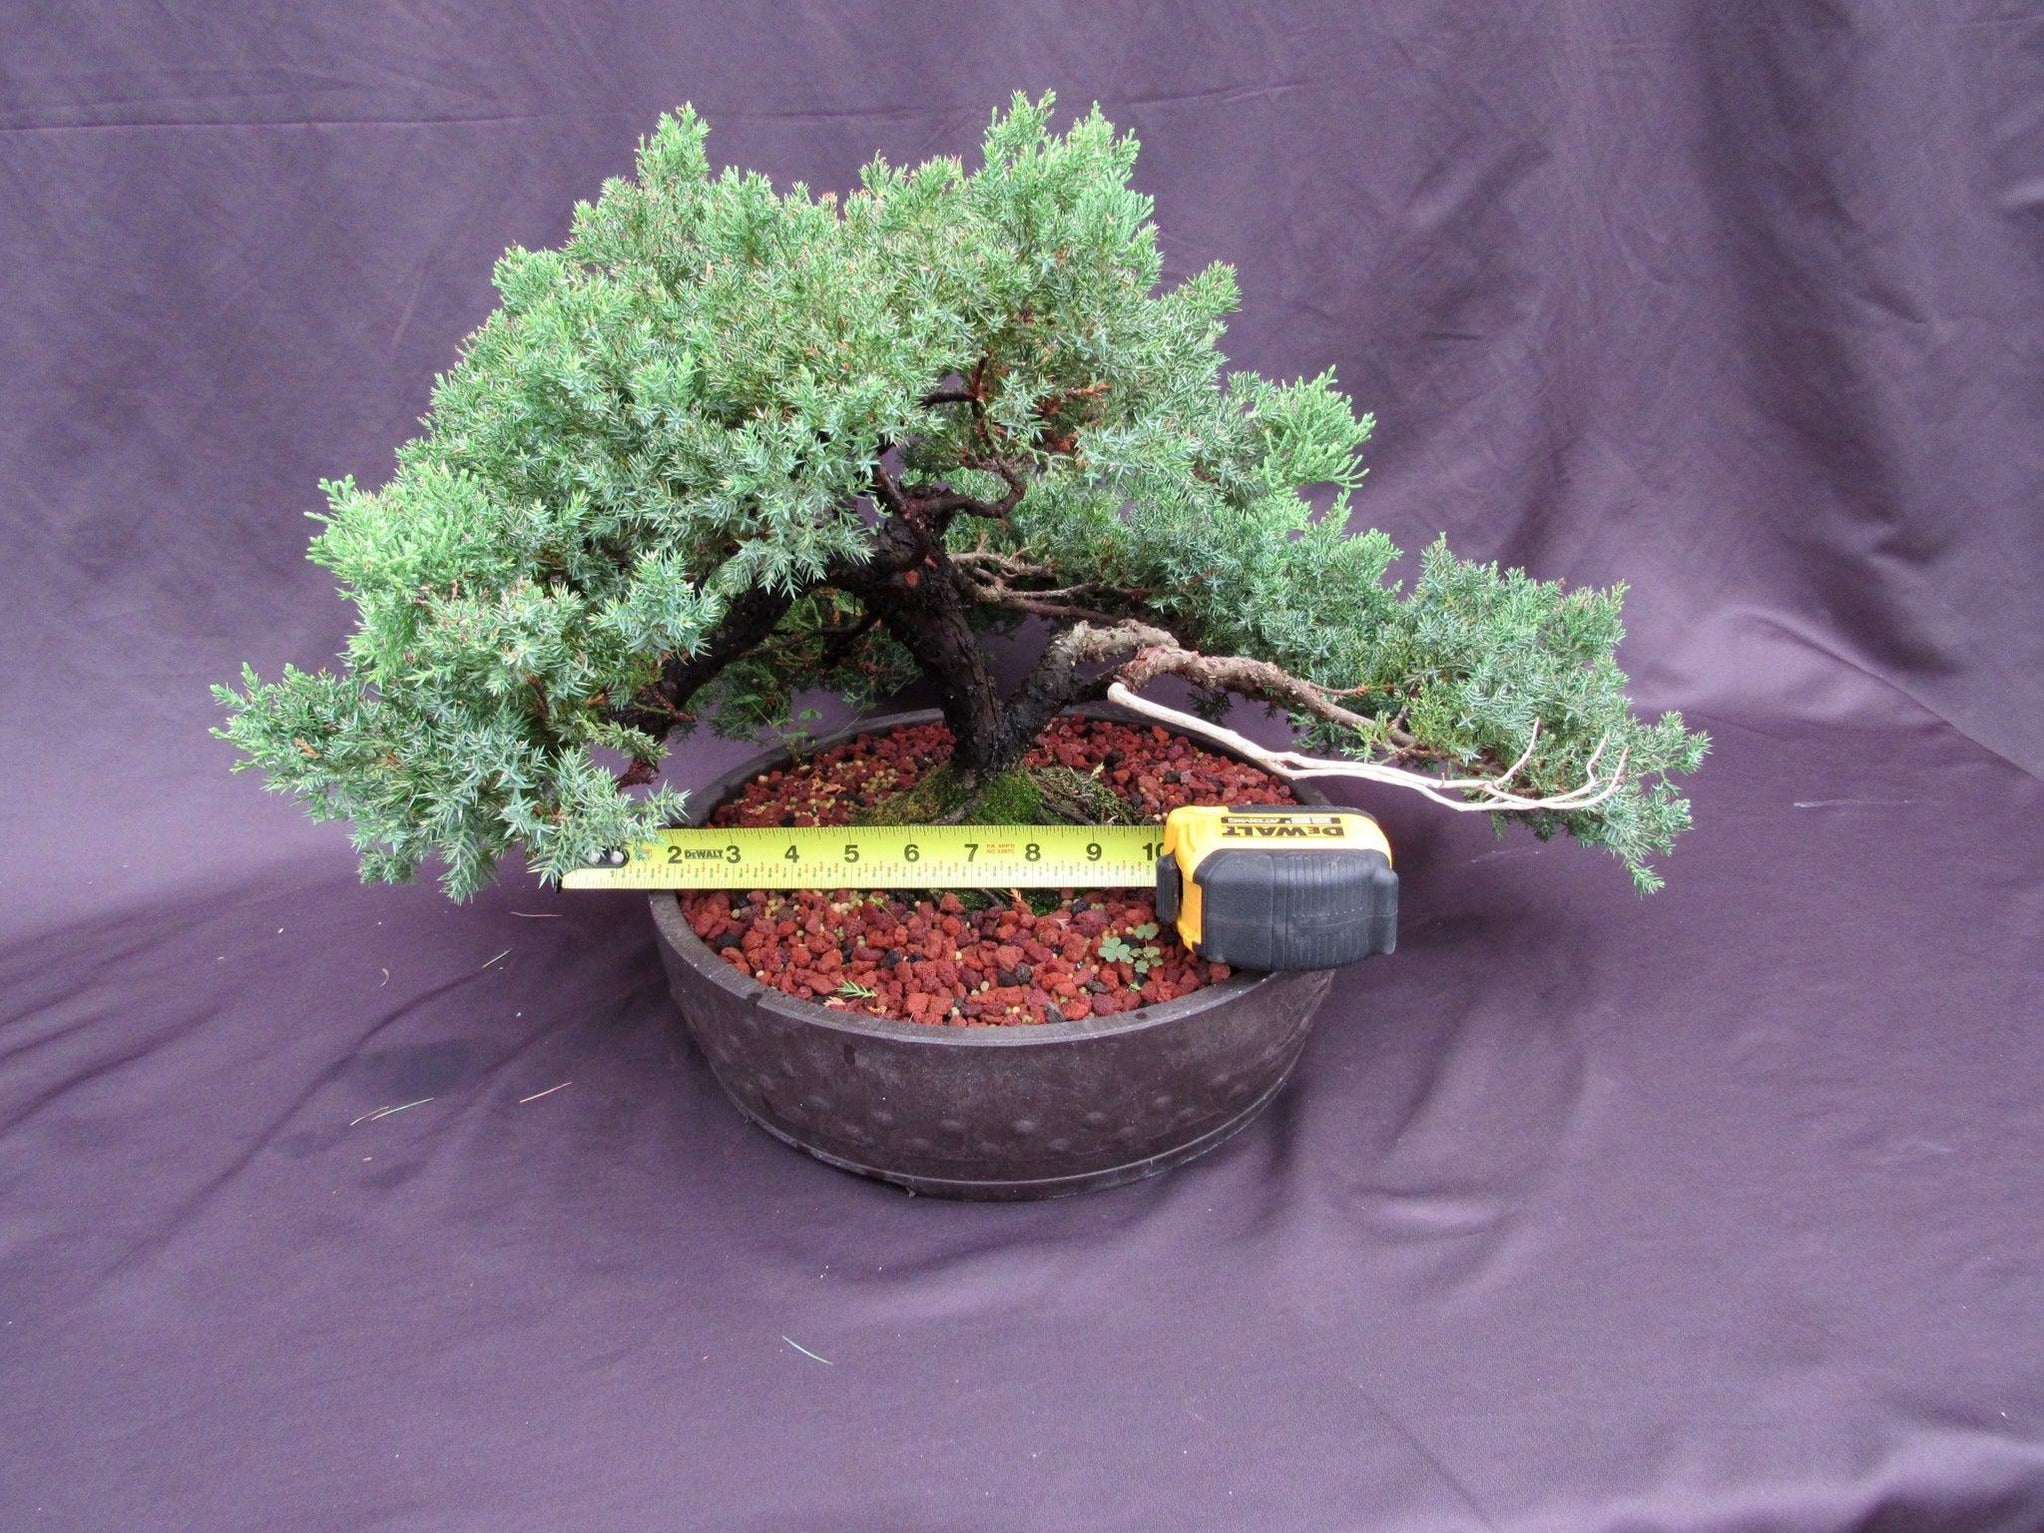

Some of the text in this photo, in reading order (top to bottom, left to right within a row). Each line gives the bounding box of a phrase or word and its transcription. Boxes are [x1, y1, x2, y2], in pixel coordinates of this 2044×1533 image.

[1222, 826, 1344, 836] DEWALT
[667, 845, 683, 864] 2
[726, 845, 741, 864] 3
[784, 845, 800, 863] 4
[844, 844, 860, 863] 5
[904, 844, 920, 863] 6
[964, 843, 979, 862] 7
[1025, 843, 1041, 862] 8
[1086, 843, 1102, 862] 9
